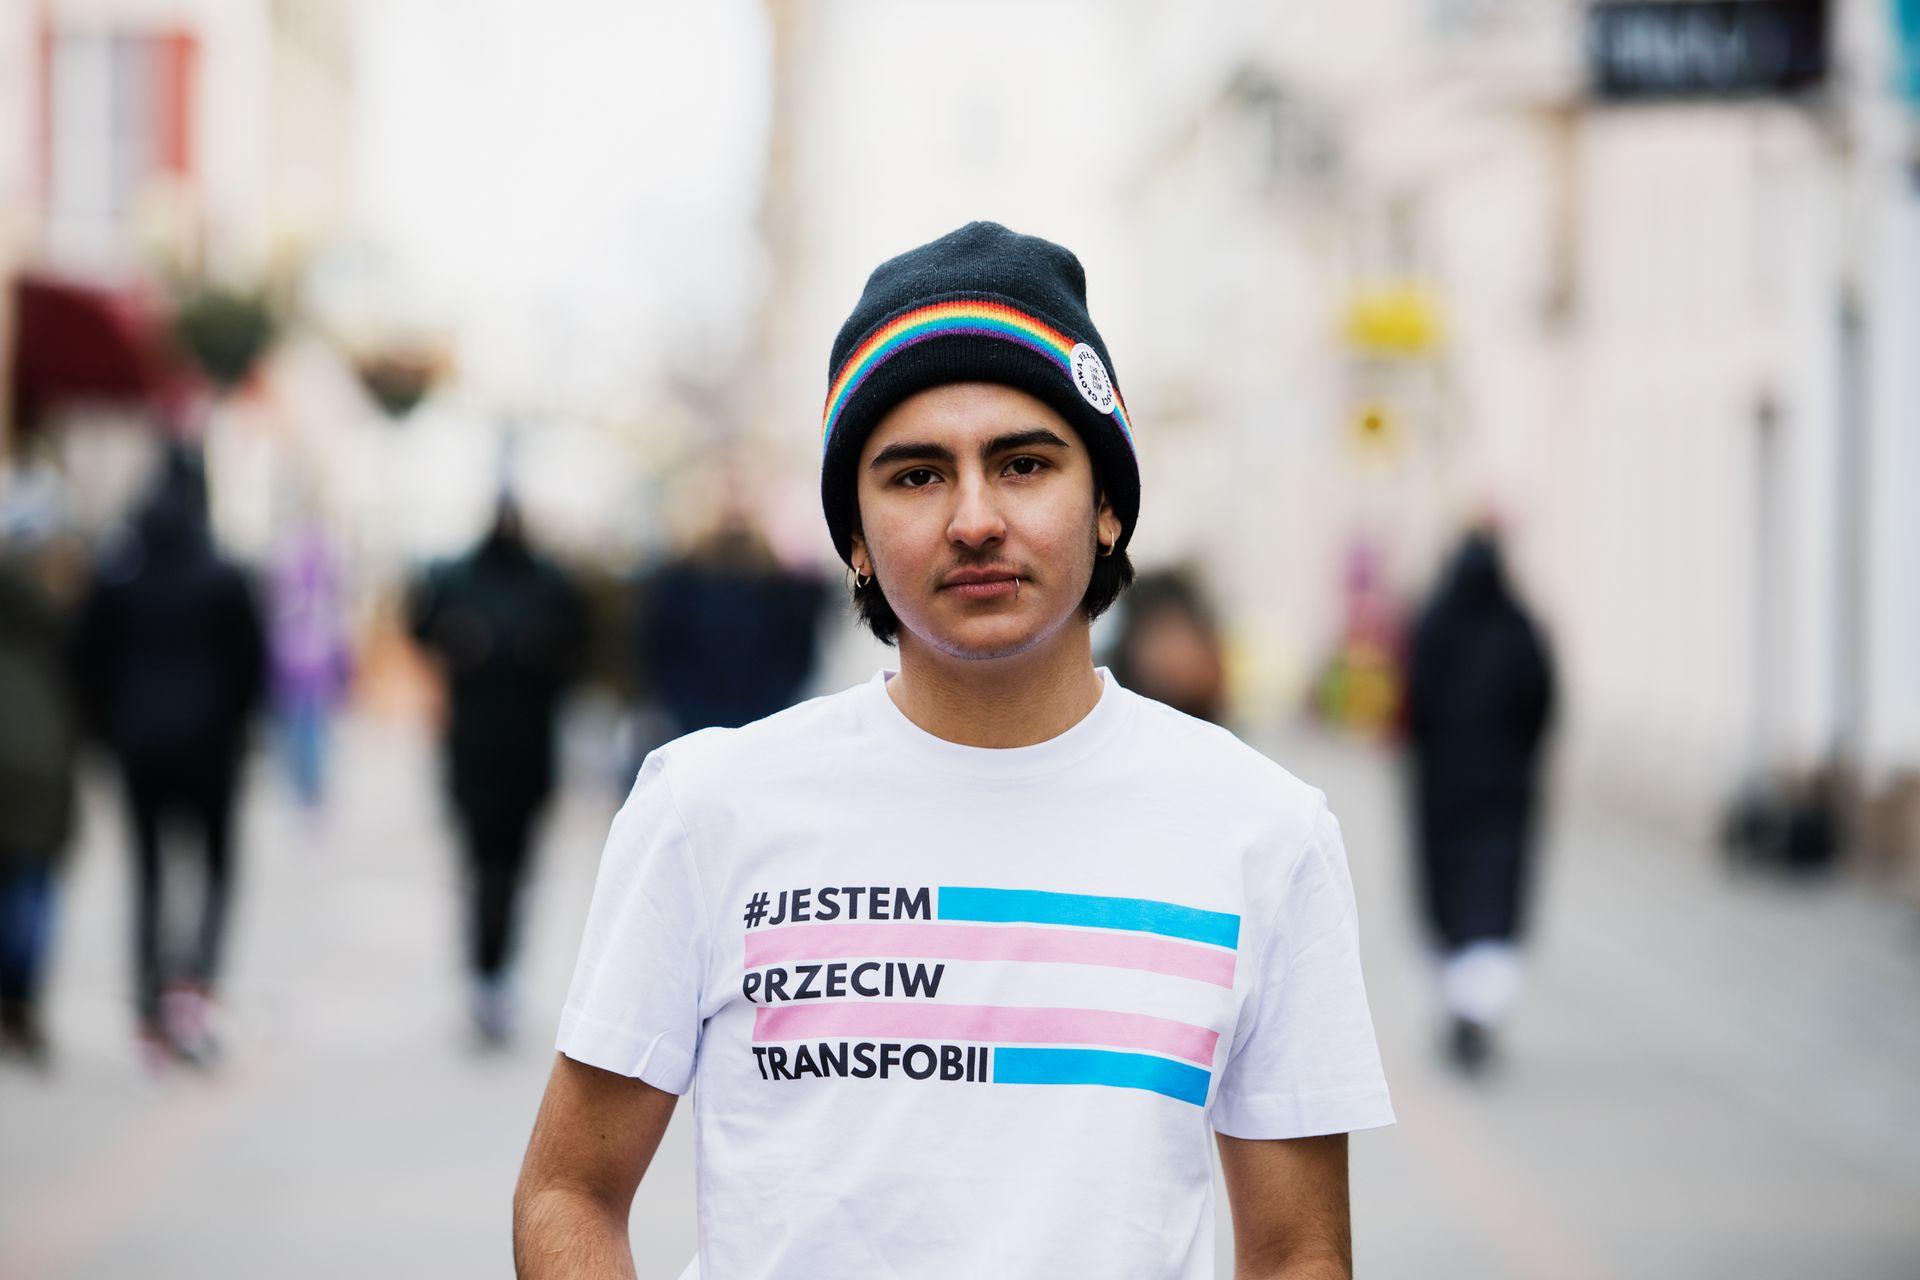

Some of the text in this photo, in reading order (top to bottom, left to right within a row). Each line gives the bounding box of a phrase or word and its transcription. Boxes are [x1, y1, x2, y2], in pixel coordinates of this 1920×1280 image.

[743, 887, 932, 929] #JESTEM
[742, 962, 945, 1004] PRZECIW
[751, 1042, 989, 1083] TRANSFOBII
